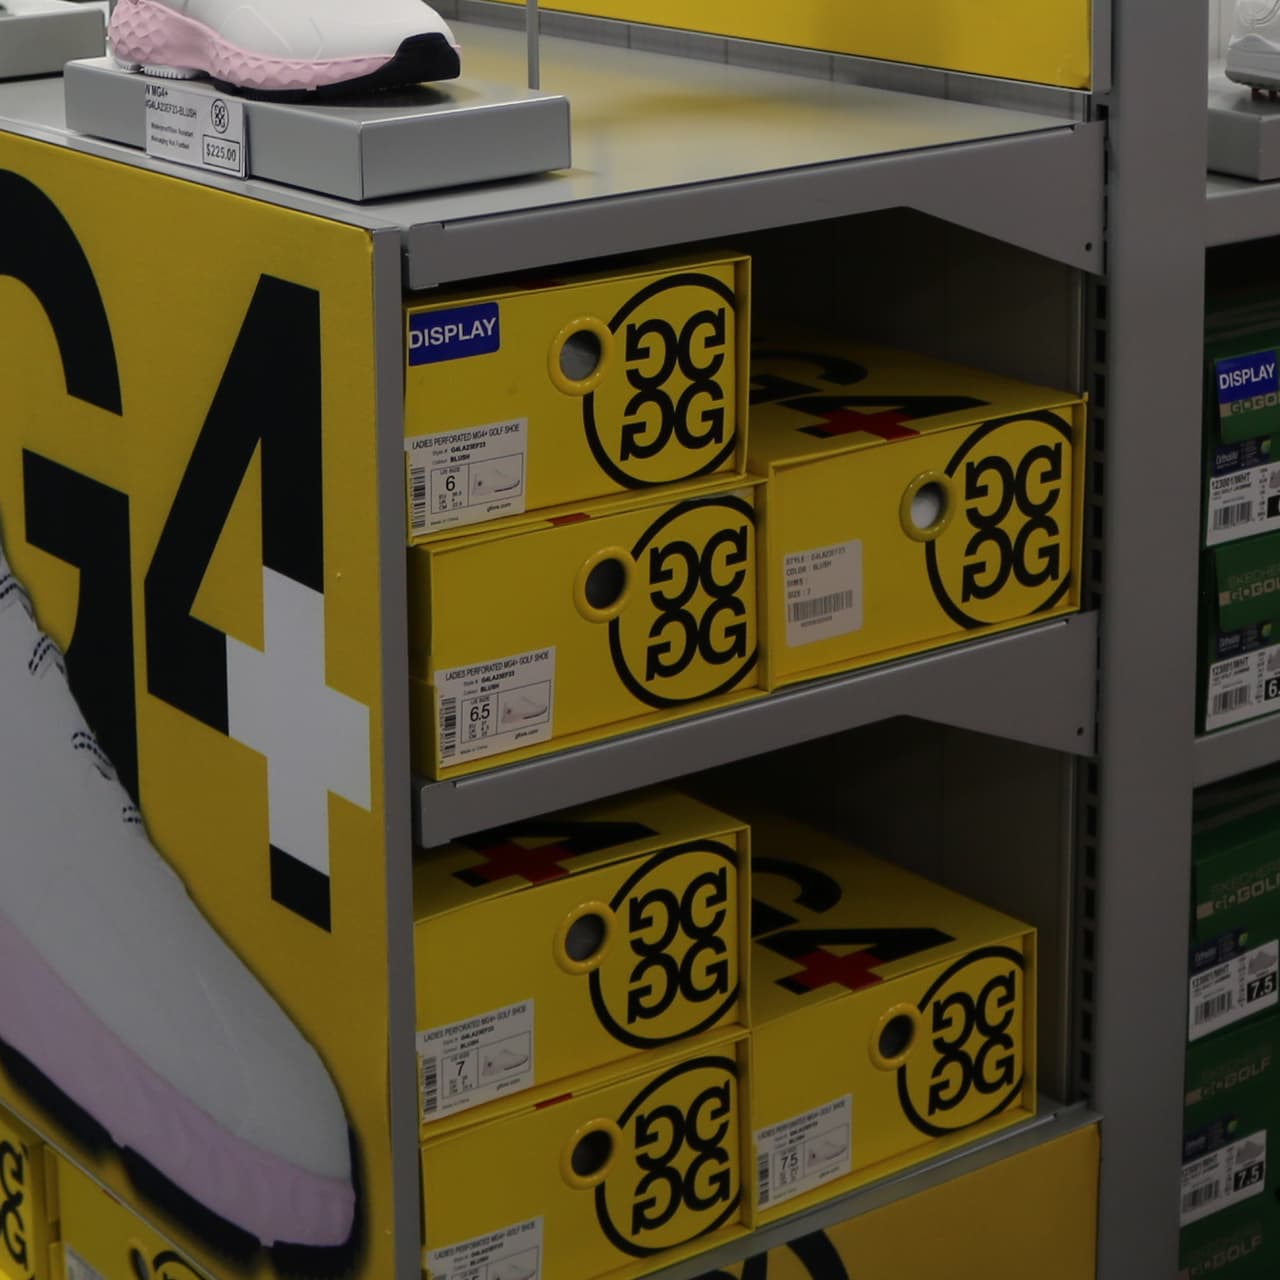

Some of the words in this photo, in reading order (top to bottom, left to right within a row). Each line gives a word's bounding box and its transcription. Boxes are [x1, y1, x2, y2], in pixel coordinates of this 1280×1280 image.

[206, 144, 236, 162] $225.00
[409, 317, 497, 349] DISPLAY
[1219, 363, 1276, 390] DISPLAY
[412, 438, 433, 450] LADIES
[434, 432, 472, 447] PERFORATED
[489, 426, 504, 437] GOLF
[505, 423, 520, 435] SHOE
[450, 454, 470, 463] BLUSH
[446, 475, 455, 492] 6
[445, 671, 465, 681] LADIES
[467, 663, 503, 678] PERFORATED
[520, 655, 533, 665] GOLF
[534, 651, 549, 662] SHOE
[470, 703, 490, 722] 6.5
[1250, 973, 1274, 1000] 7.5
[456, 1061, 465, 1076] 7
[1237, 1164, 1262, 1189] 7.5
